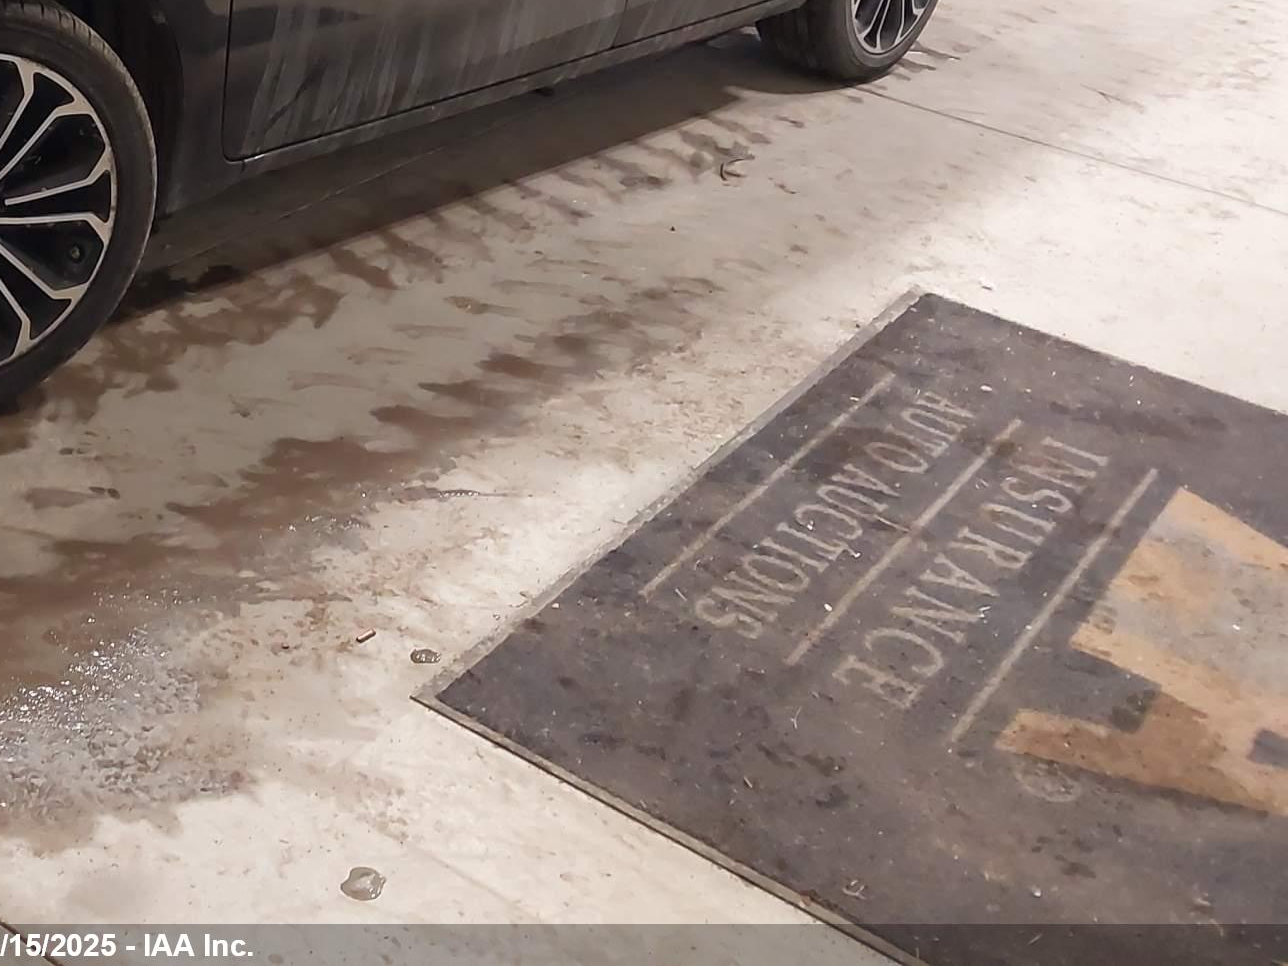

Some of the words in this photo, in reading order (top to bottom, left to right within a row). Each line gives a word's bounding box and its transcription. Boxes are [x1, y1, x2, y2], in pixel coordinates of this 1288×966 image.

[867, 390, 978, 475] AUTO
[693, 463, 900, 640] AUCTIONS
[831, 436, 1109, 709] INSURANCE
